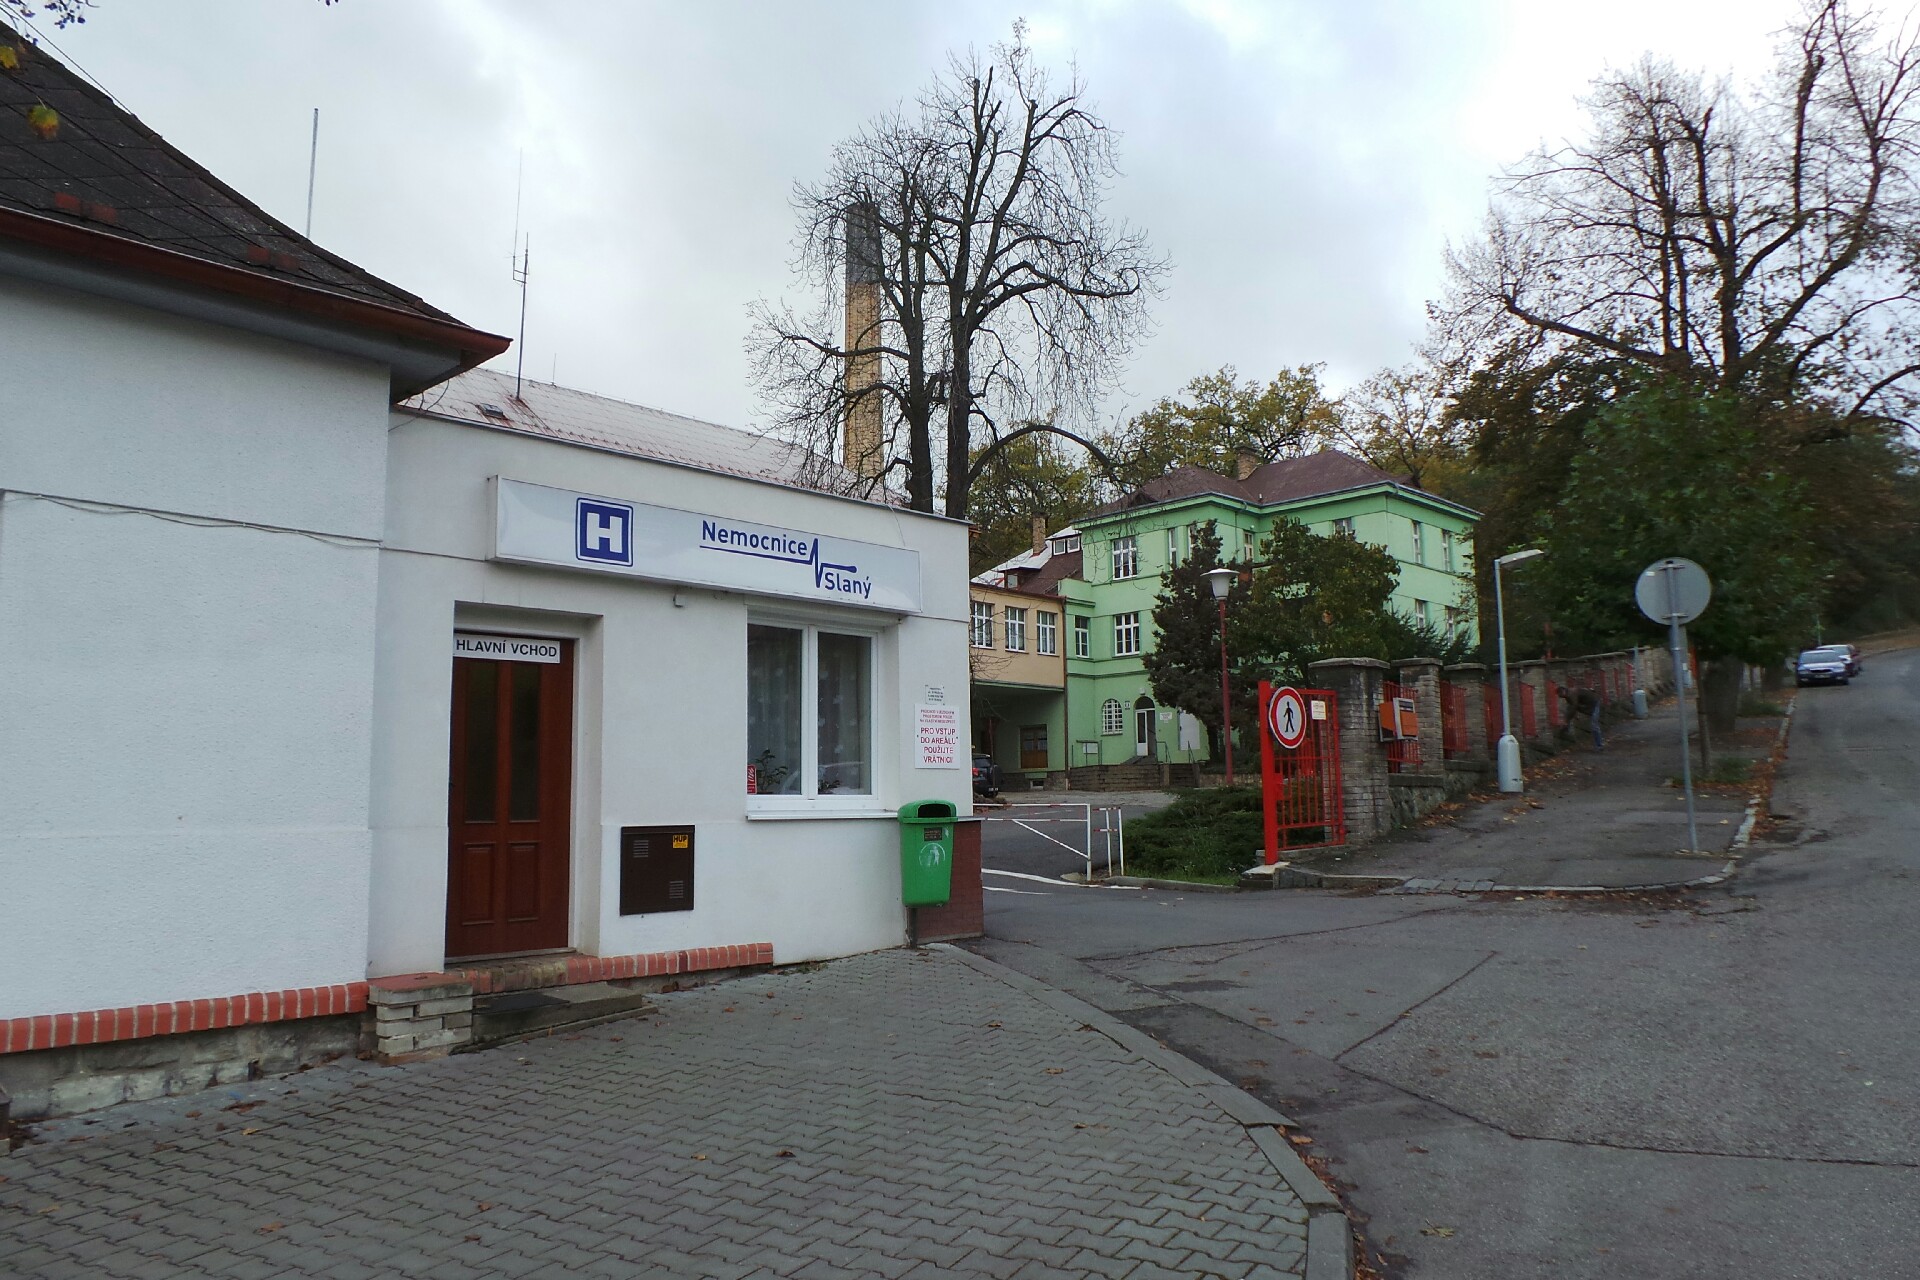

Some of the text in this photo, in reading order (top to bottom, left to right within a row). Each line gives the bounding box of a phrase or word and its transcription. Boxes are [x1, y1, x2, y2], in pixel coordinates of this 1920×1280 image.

[586, 512, 623, 554] H
[702, 519, 808, 556] Nemocnice
[824, 572, 872, 599] Slaný
[456, 639, 557, 657] HLAVNÍ VCHOD
[920, 727, 956, 736] PRO VSTUP
[920, 735, 956, 745] DO AREÁLU
[923, 745, 954, 754] POUŽIJTE
[923, 755, 954, 764] VRÁTNICI
[673, 834, 688, 843] HUP
